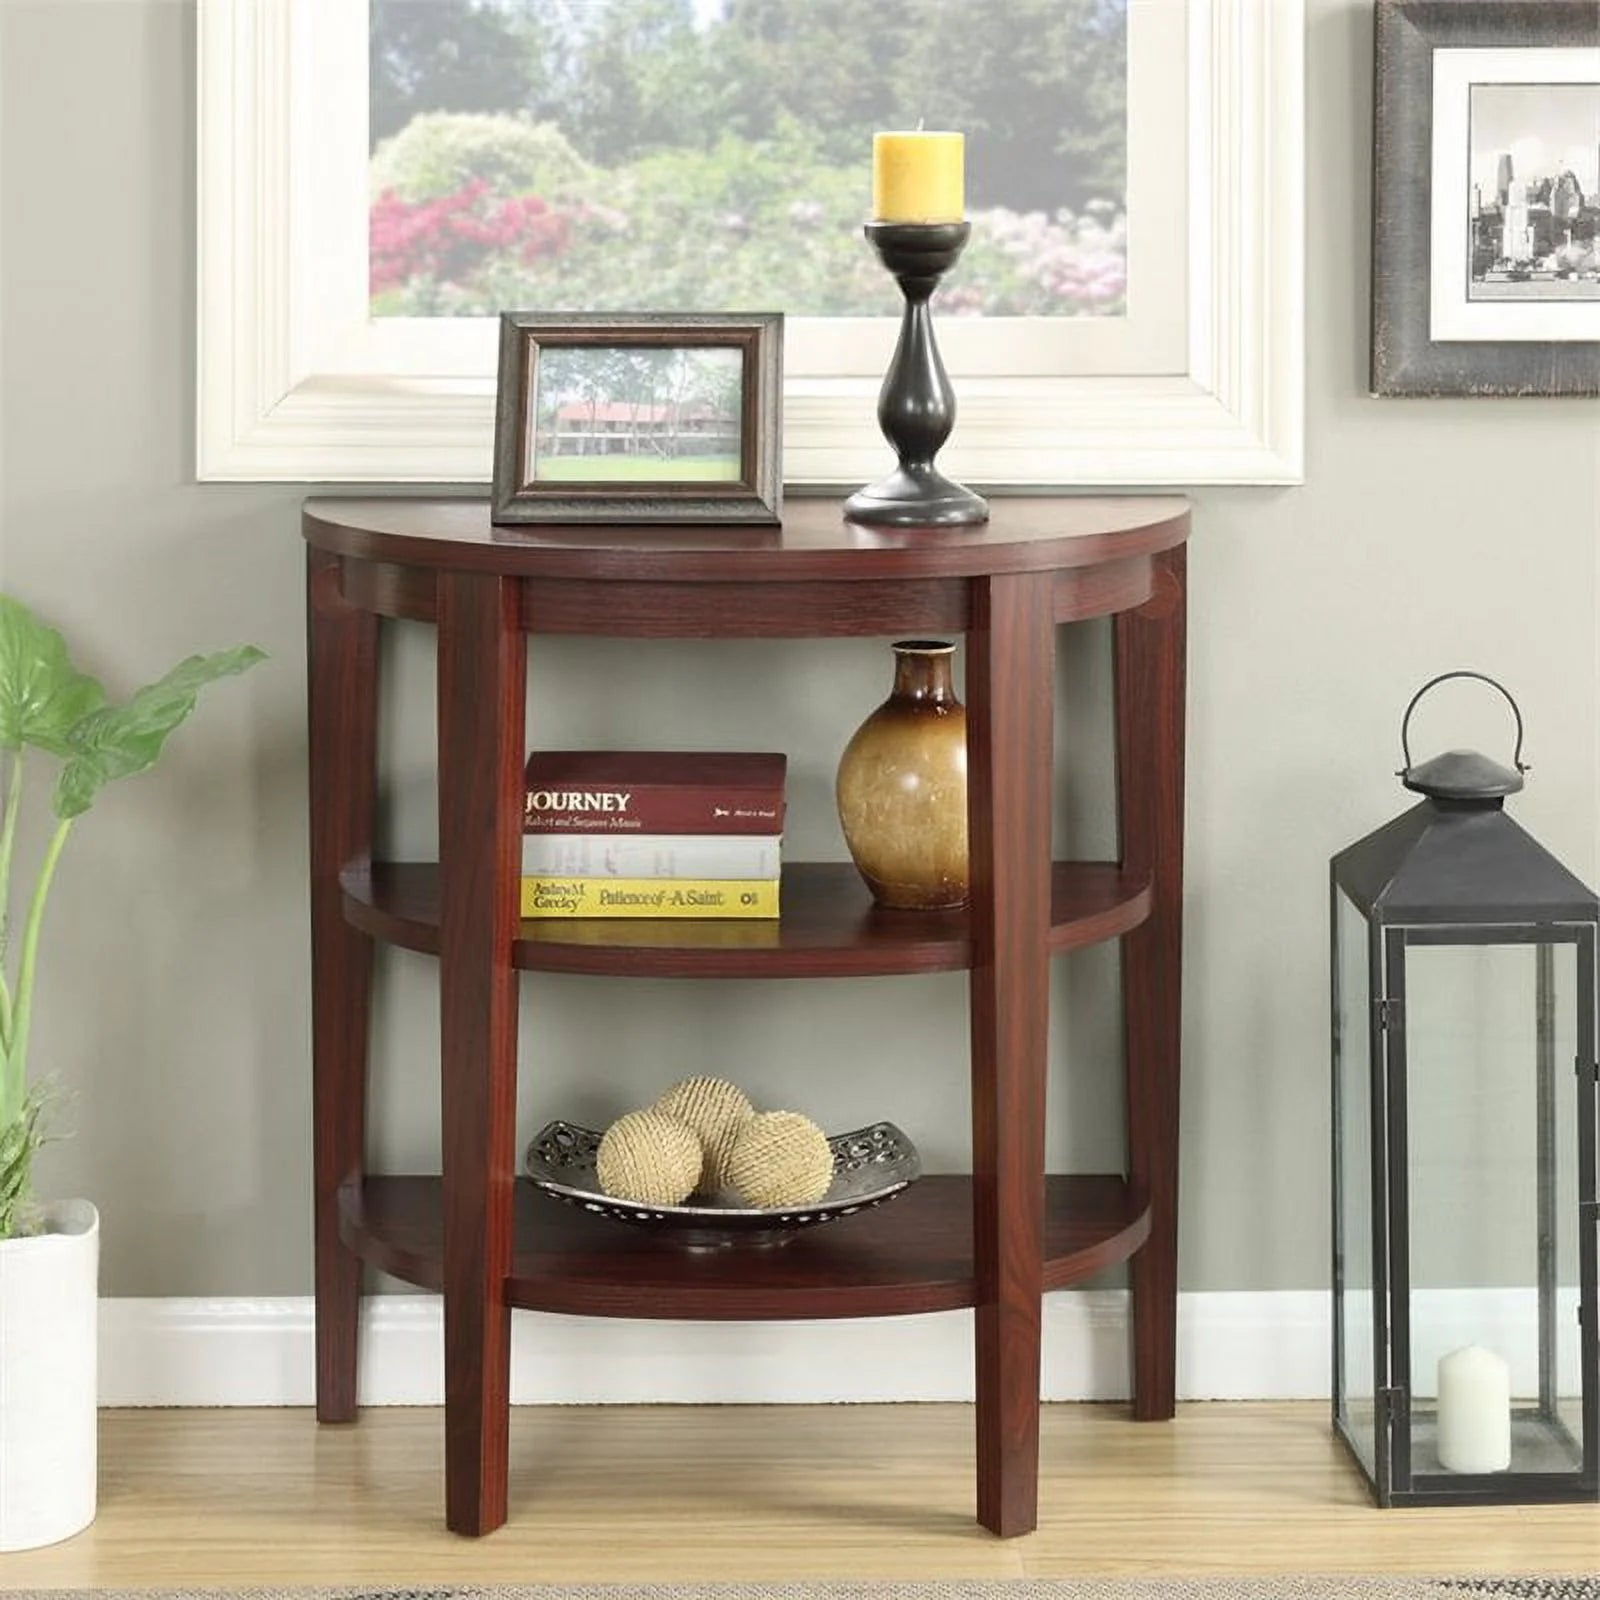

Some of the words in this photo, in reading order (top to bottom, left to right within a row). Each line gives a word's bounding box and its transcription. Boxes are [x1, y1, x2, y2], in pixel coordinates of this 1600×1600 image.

[525, 791, 631, 812] JOURNEY
[600, 889, 651, 905] Patience
[652, 889, 666, 907] of
[687, 889, 724, 906] Saint
